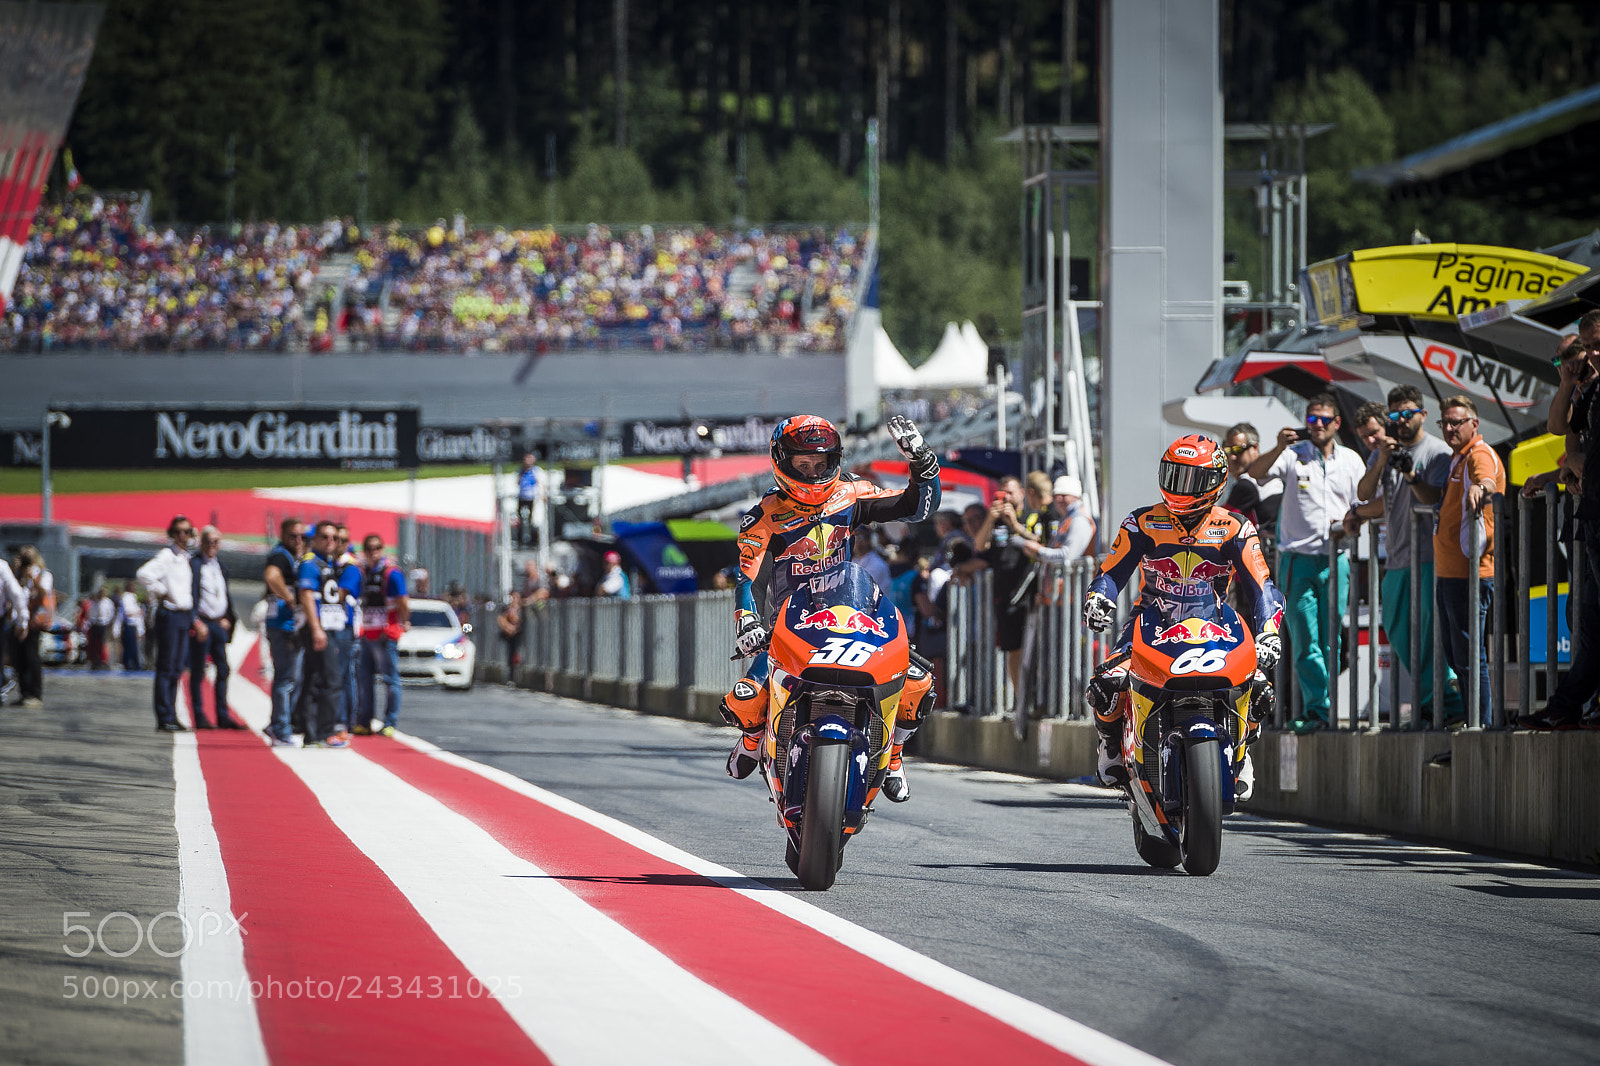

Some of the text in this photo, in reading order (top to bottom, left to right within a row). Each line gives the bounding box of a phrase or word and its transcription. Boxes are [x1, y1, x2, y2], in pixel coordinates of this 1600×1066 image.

[154, 411, 398, 458] NeroGiardini
[792, 547, 846, 575] Red Bull
[1156, 576, 1214, 596] Red Bull
[807, 637, 877, 667] 36
[1170, 648, 1226, 675] 66
